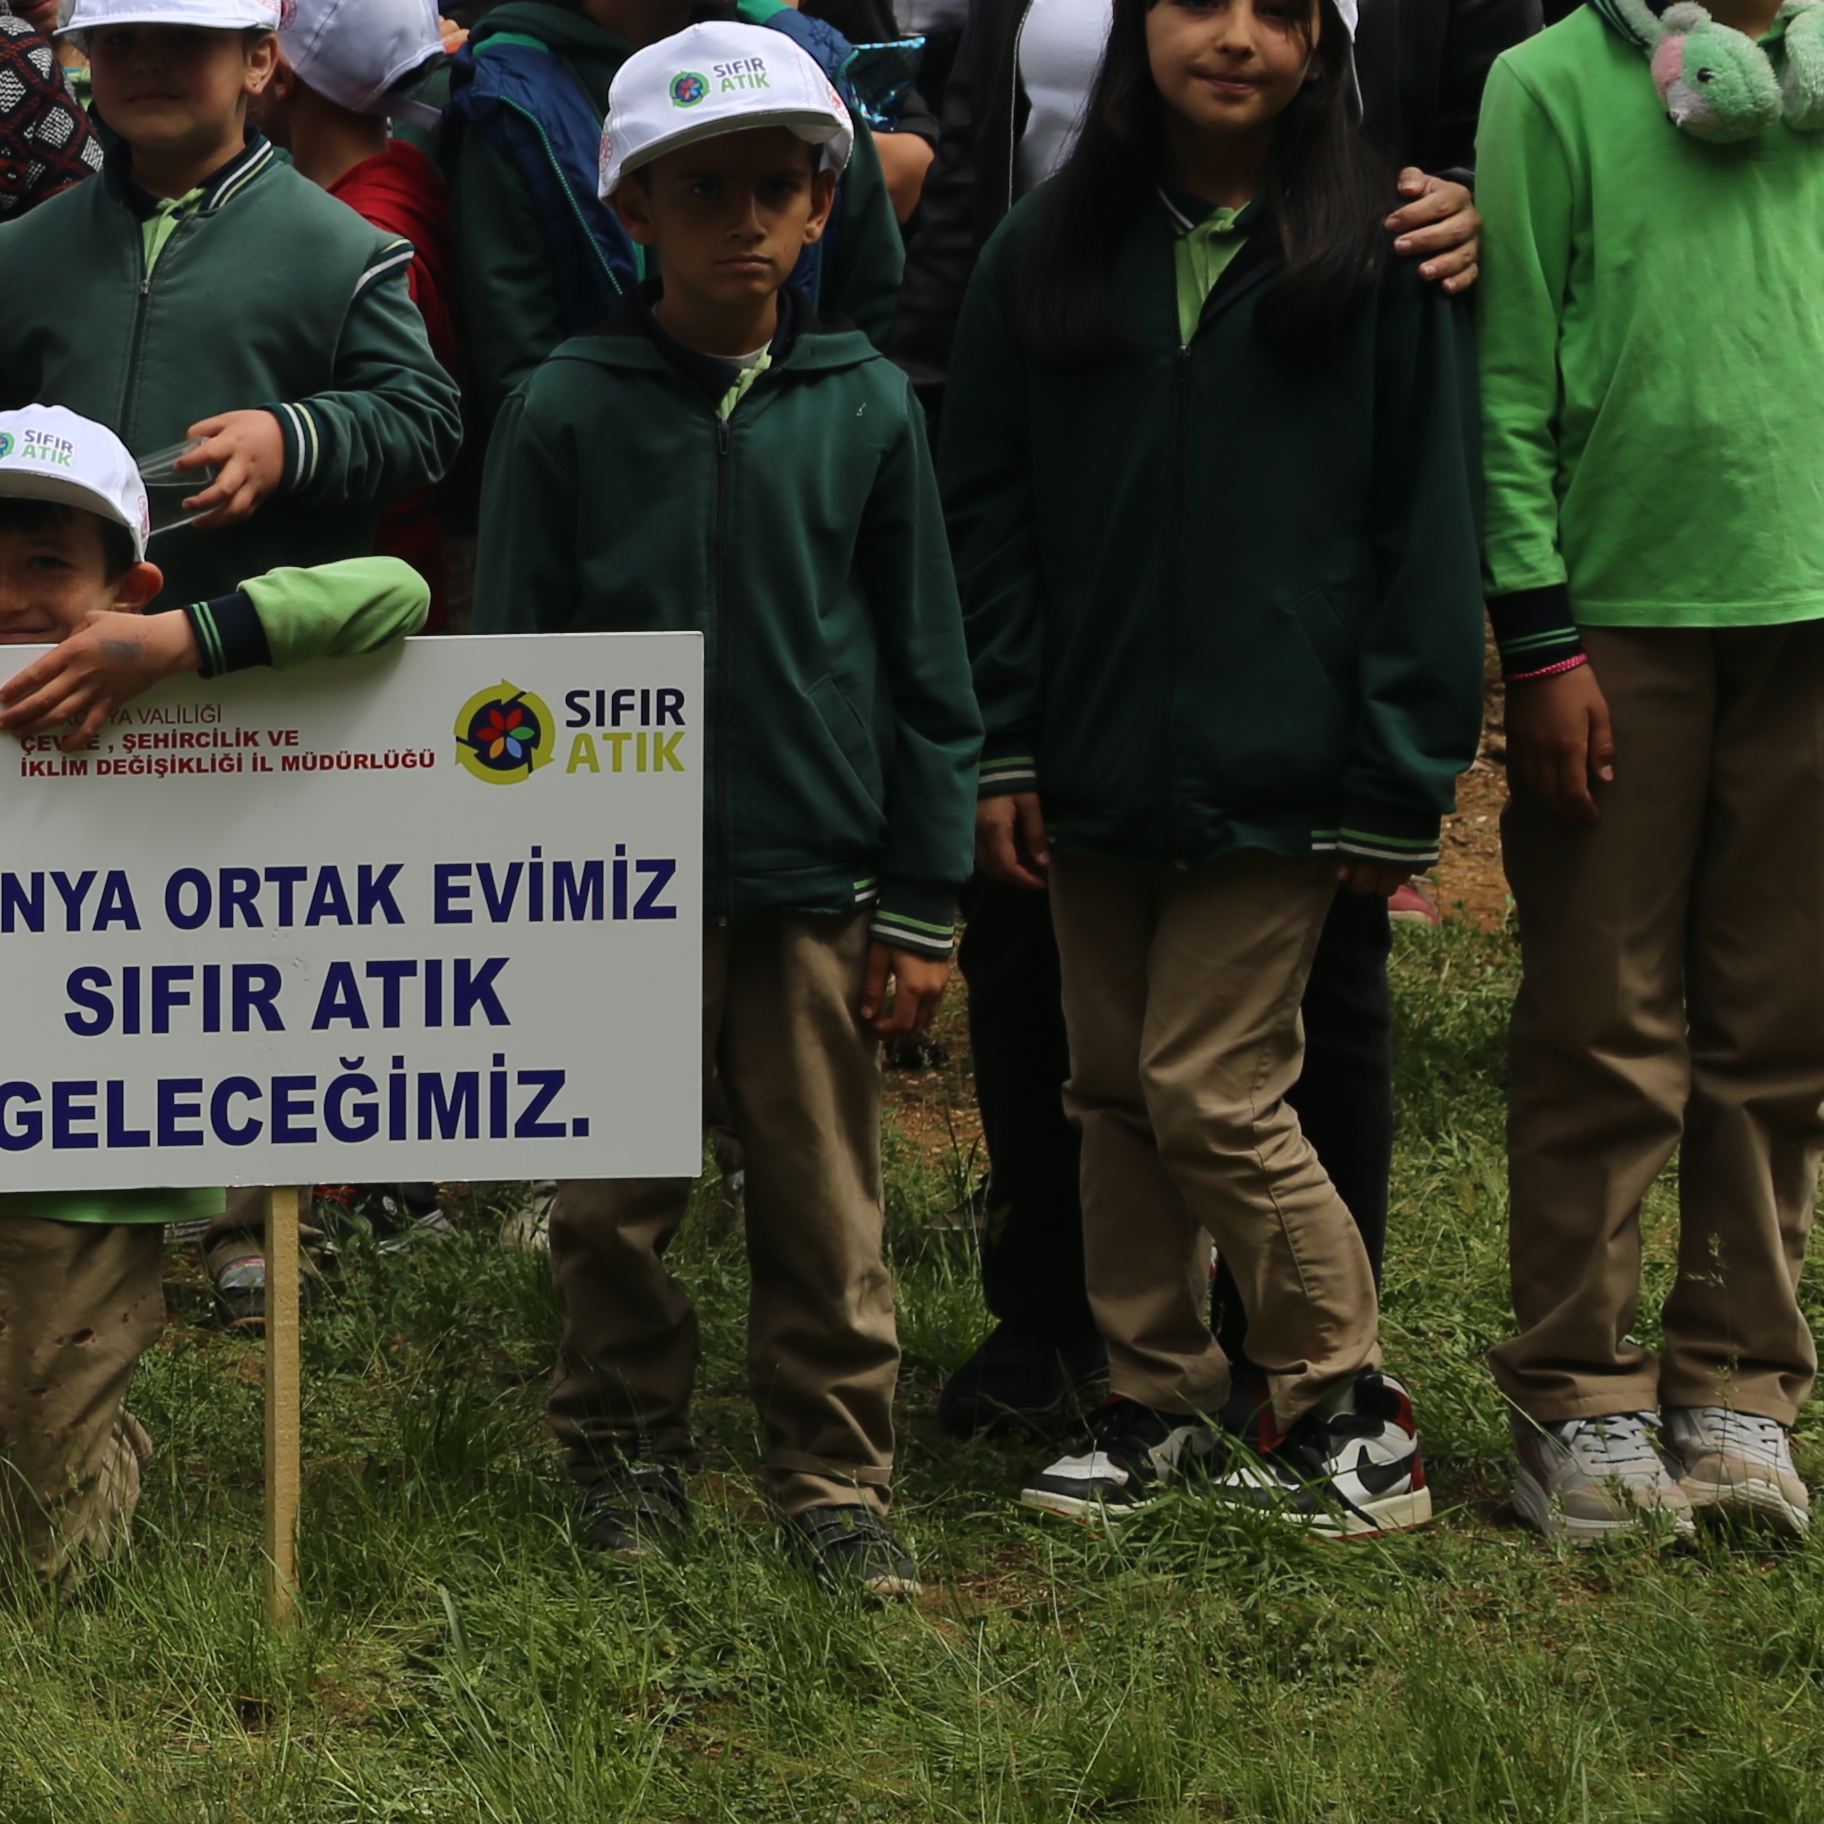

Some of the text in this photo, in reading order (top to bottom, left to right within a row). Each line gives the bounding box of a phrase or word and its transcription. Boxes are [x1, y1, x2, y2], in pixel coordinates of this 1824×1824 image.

[714, 57, 765, 77] SIFIR
[721, 72, 770, 91] ATIK
[25, 429, 73, 453] SIFIR
[23, 444, 73, 467] ATIK
[138, 703, 221, 724] VALİLİĞİ
[564, 687, 686, 728] SIFIR
[19, 730, 298, 754] ÇEVE ŞEHİRCİLİK VE
[566, 730, 686, 774] ATIK
[20, 749, 435, 778] İKLİM DEĞİŞİKLİĞİ İL MÜDÜRLÜĞÜ
[163, 862, 406, 930] ORTAK
[432, 843, 678, 923] EVİMİZ
[62, 956, 513, 1036] SIFIR ATIK
